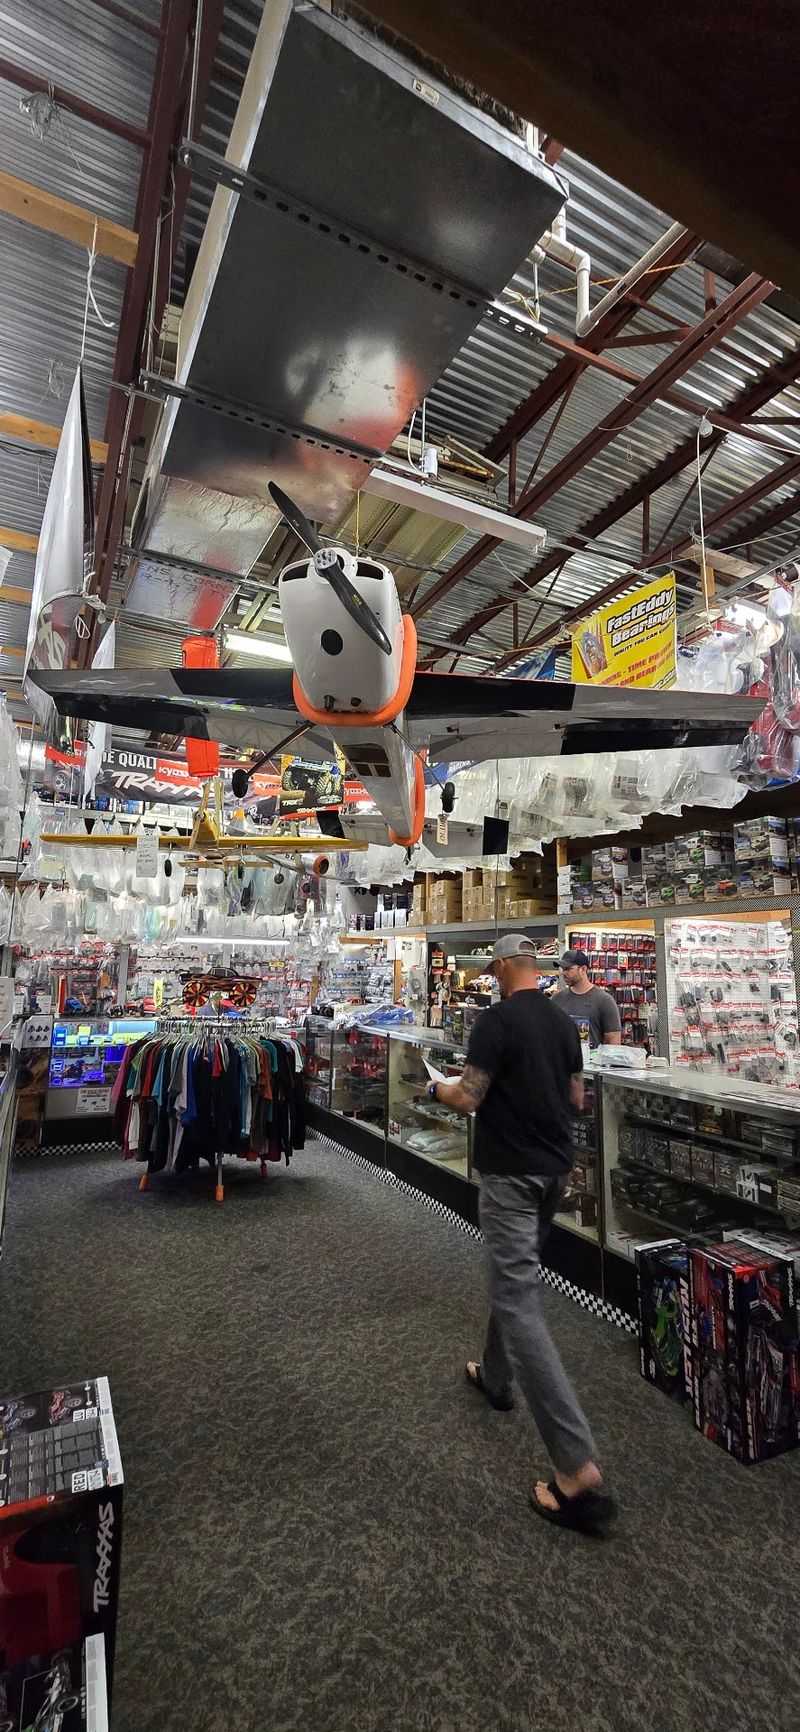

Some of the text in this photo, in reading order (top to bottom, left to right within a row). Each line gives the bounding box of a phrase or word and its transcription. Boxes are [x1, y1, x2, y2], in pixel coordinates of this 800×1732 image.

[606, 588, 674, 634] FastEddy
[612, 605, 675, 647] Bearings
[73, 1472, 86, 1492] RED
[94, 1502, 115, 1613] TRAXXAS
